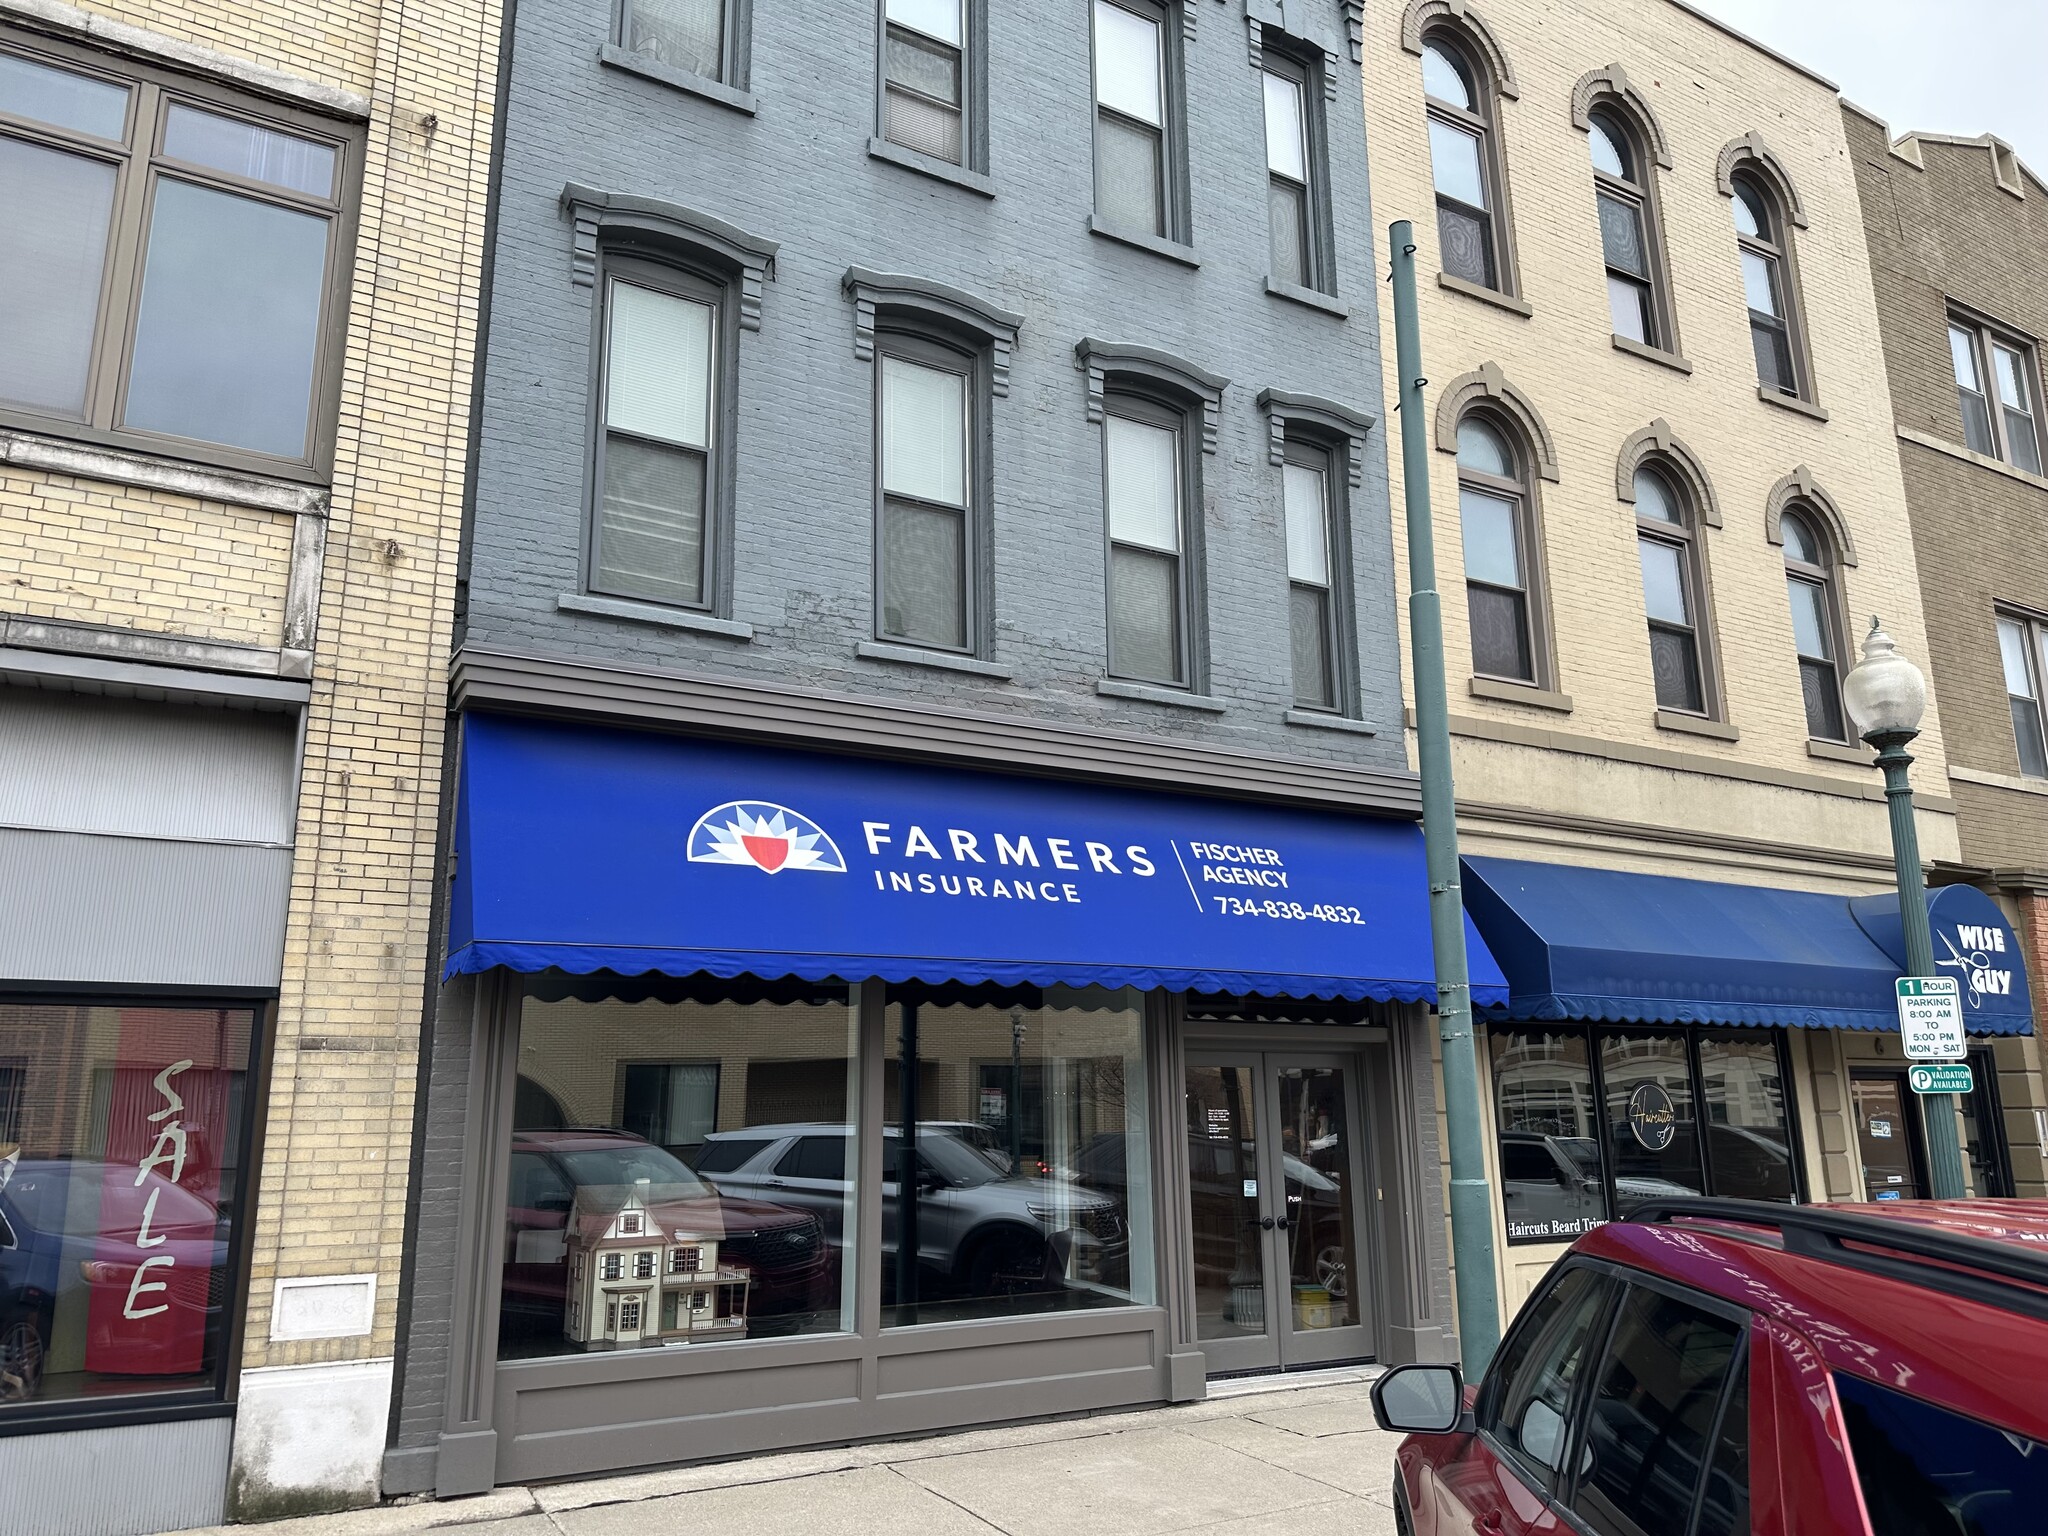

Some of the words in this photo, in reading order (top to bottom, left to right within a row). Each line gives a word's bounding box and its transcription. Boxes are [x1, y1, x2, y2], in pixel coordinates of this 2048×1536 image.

[862, 821, 1156, 877] FARMERS
[1189, 841, 1284, 867] FISCHER
[1203, 864, 1289, 889] AGENCY
[874, 870, 1082, 903] INSURANCE
[1213, 896, 1366, 925] 734-838-4832
[1956, 924, 2005, 952] WISE
[1905, 980, 1914, 995] 1
[1922, 982, 1952, 991] HOUR
[1971, 968, 2011, 995] GUY
[1907, 998, 1951, 1007] PARKING
[1909, 1010, 1932, 1018] 8:00
[1936, 1010, 1951, 1018] AM
[1925, 1021, 1939, 1029] TO
[1913, 1033, 1935, 1041] 5:00
[1939, 1033, 1954, 1041] PM
[1943, 1044, 1960, 1052] SAT
[1931, 1071, 1970, 1079] VALIDATION
[1933, 1080, 1968, 1089] AVAILABLE
[123, 1059, 194, 1319] SALE
[1508, 1221, 1549, 1236] Haircuts
[1551, 1219, 1581, 1234] Beard
